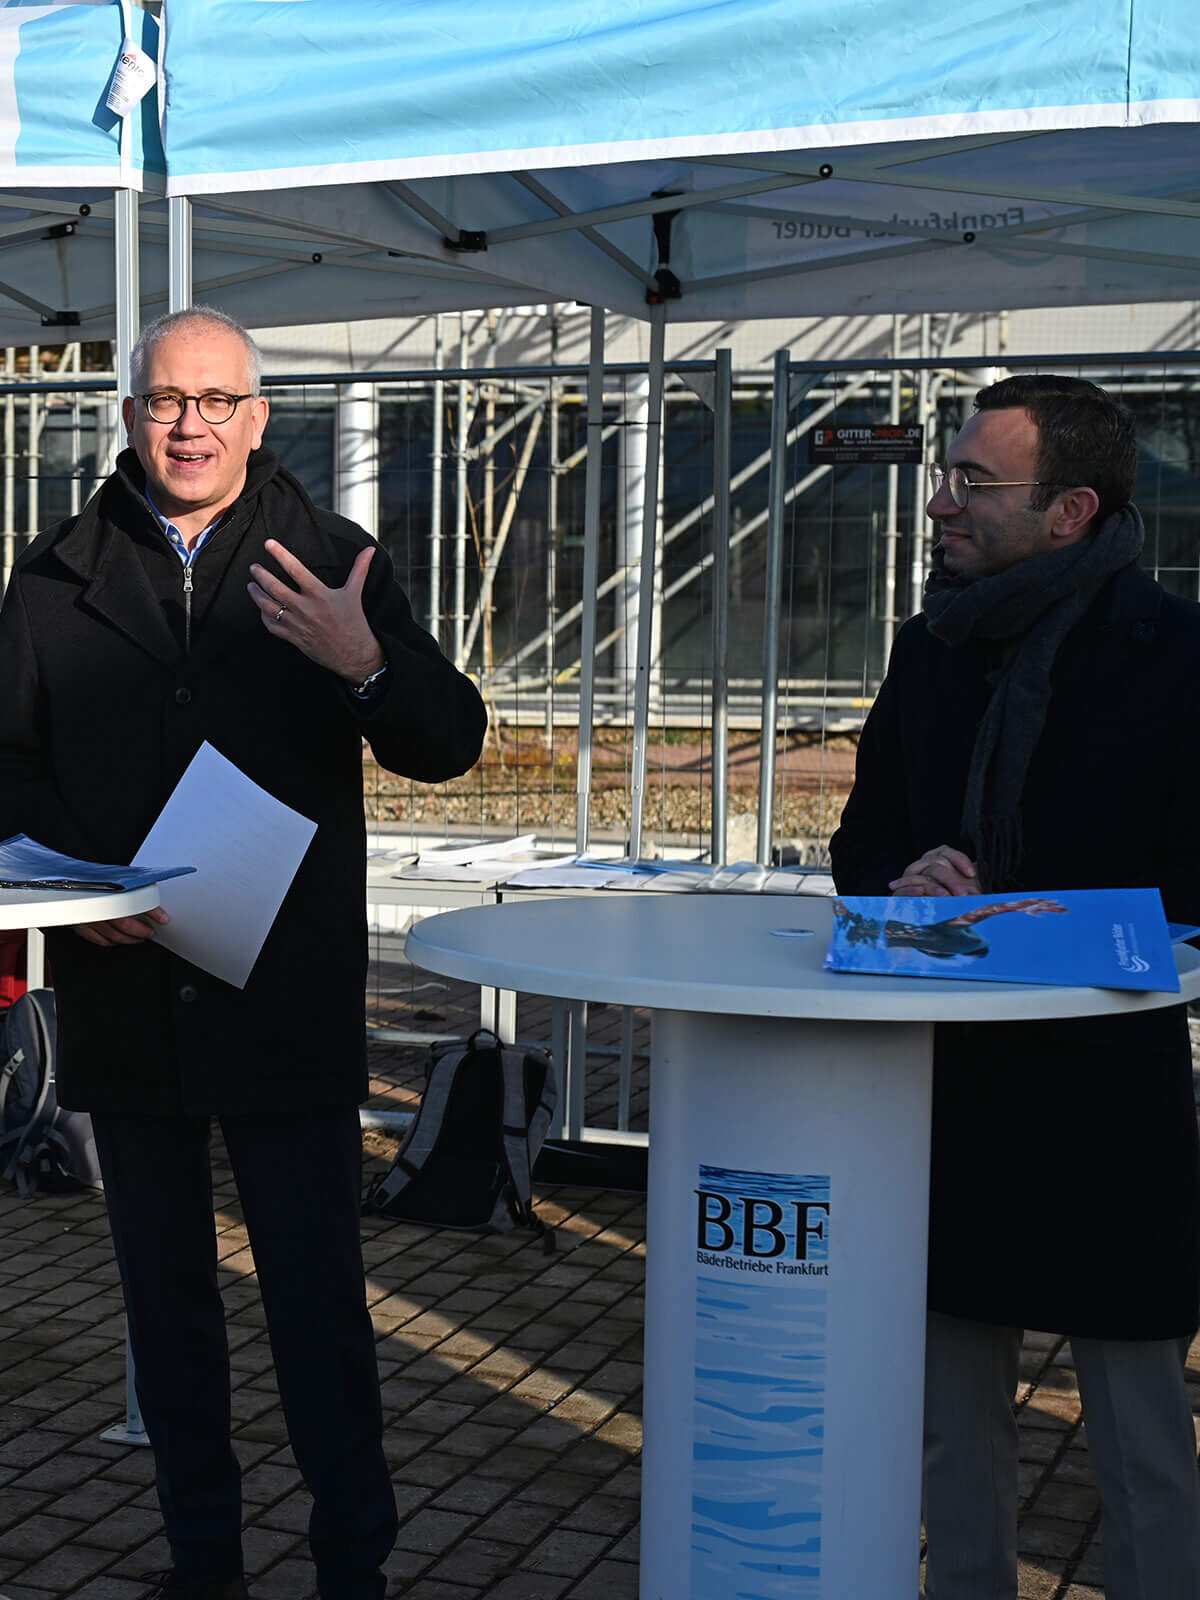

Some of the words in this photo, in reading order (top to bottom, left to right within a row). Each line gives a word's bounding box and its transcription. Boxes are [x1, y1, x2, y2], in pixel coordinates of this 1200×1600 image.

[694, 1189, 831, 1260] BBF
[696, 1251, 773, 1274] BäderBetriebe
[776, 1262, 830, 1276] Frankfurt
